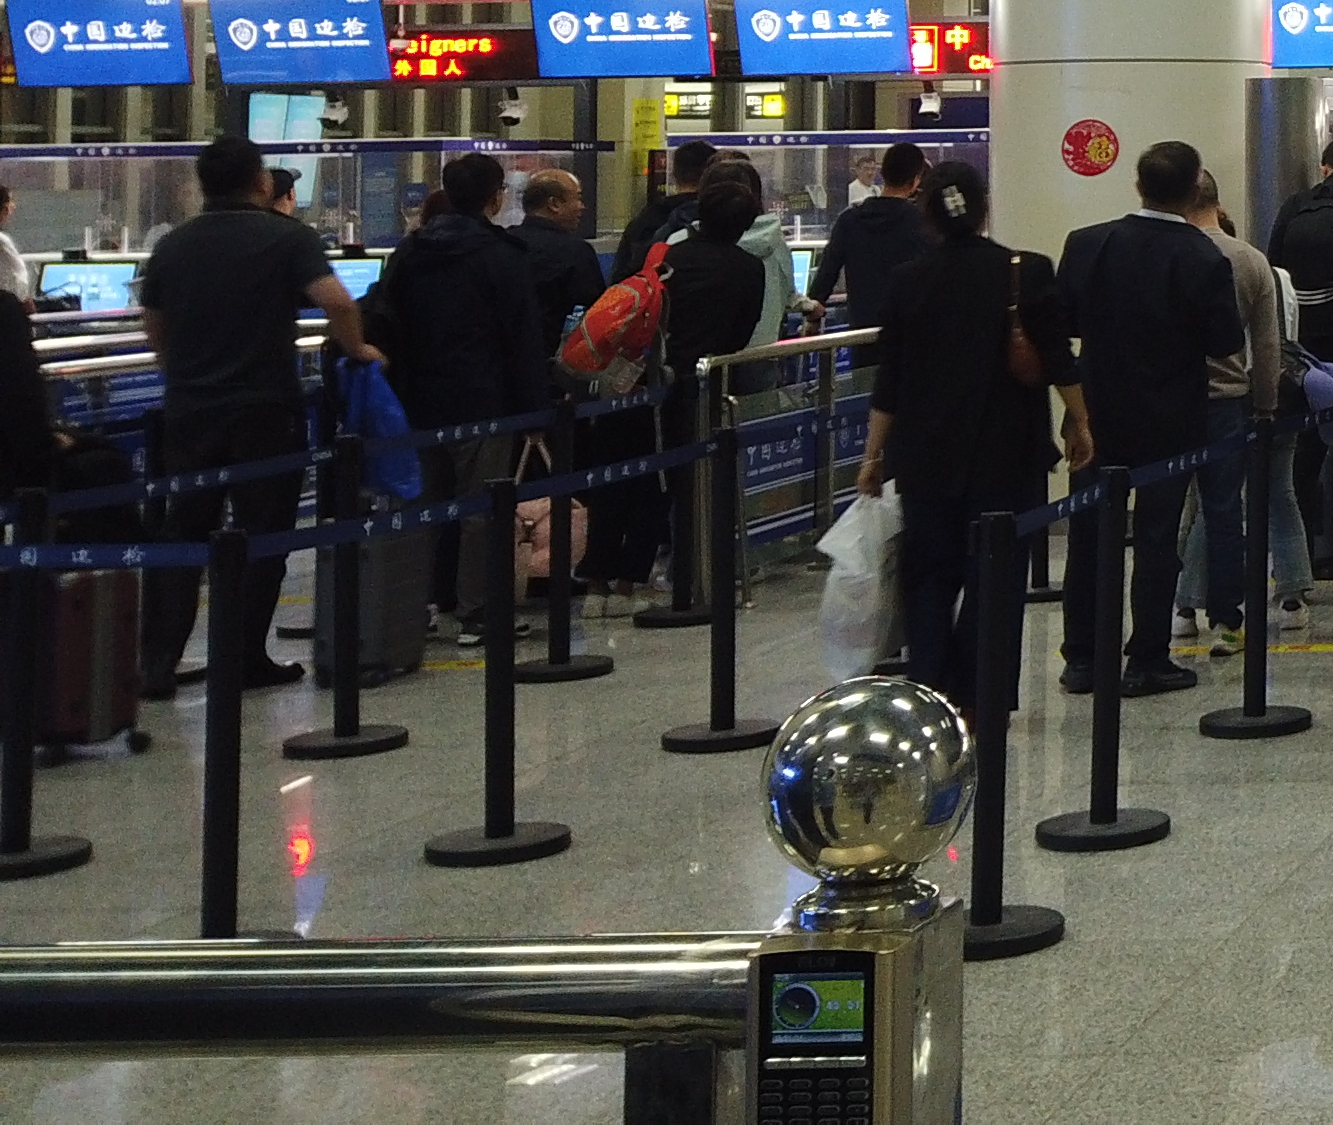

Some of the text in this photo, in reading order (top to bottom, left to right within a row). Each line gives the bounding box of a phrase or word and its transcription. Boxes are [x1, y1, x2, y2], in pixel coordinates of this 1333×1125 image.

[60, 19, 167, 43] 中国边检
[262, 16, 368, 40] 中国边检
[583, 10, 691, 34] 中国边检
[945, 25, 971, 51] 中
[395, 59, 463, 78] 外国人
